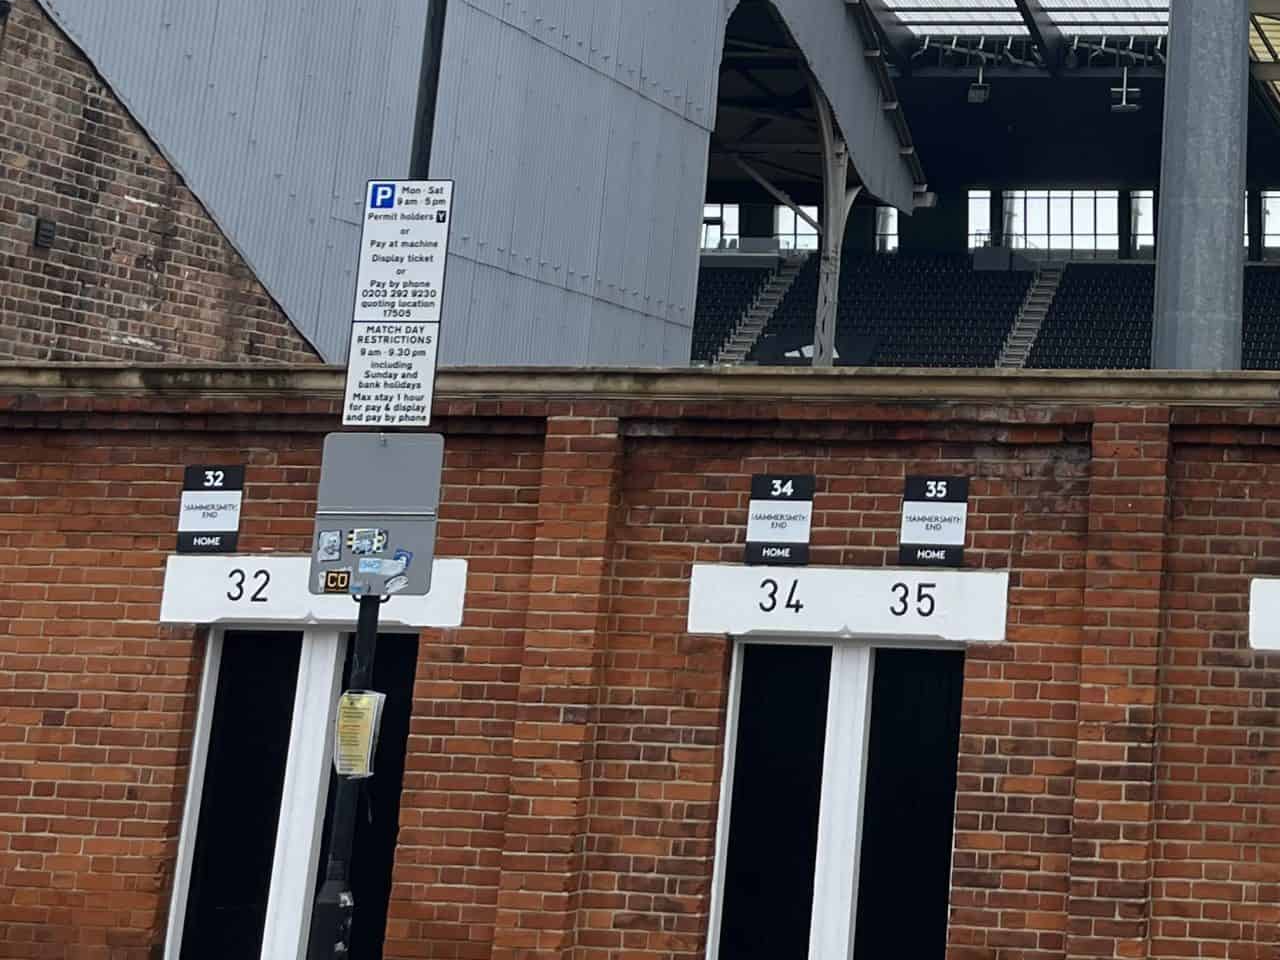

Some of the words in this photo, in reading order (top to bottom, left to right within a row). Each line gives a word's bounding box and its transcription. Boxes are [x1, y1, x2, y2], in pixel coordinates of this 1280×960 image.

[401, 186, 421, 194] Mon
[428, 186, 444, 194] Sat
[375, 186, 393, 207] P
[397, 197, 403, 206] 9
[404, 198, 418, 206] am
[425, 197, 431, 205] 5
[432, 198, 446, 207] pm
[367, 212, 398, 221] Permit
[400, 212, 434, 221] holders
[438, 211, 446, 222] Y
[370, 239, 386, 249] Pay
[388, 239, 398, 248] at
[401, 239, 438, 248] machine
[371, 253, 405, 264] Display
[407, 253, 434, 263] ticket
[396, 268, 406, 276] or
[370, 279, 386, 289] Pay
[388, 279, 400, 289] by
[402, 280, 431, 289] phone
[361, 289, 387, 298] 0203
[361, 300, 396, 309] quoting
[398, 300, 435, 308] location
[383, 309, 411, 318] 17505
[366, 325, 402, 334] MATCH
[405, 325, 425, 334] DAY
[357, 335, 432, 344] RESTRICTIONS
[360, 347, 367, 357] 9
[368, 348, 382, 357] am
[412, 349, 426, 358] pm
[370, 360, 413, 371] including
[364, 370, 399, 380] Sunday
[401, 370, 418, 379] and
[358, 380, 382, 389] bank
[383, 380, 422, 390] holidays
[353, 393, 372, 401] Max
[374, 392, 394, 402] stay
[403, 392, 424, 401] hour
[349, 402, 363, 411] for
[364, 403, 382, 413] pay
[384, 403, 391, 412] &
[393, 403, 426, 413] display
[346, 413, 364, 422] and
[365, 413, 383, 423] pay
[384, 413, 396, 423] by
[398, 413, 427, 423] phone
[203, 470, 224, 487] 32
[771, 480, 794, 496] 34
[925, 481, 947, 498] 35
[184, 503, 238, 512] HAMMERSMITH
[202, 511, 218, 520] END
[751, 512, 808, 522] HAMMERSMITH
[906, 515, 961, 524] HAMMERSMITH
[771, 521, 787, 529] END
[925, 524, 942, 532] END
[193, 536, 221, 546] HOME
[762, 547, 791, 558] HOME
[916, 549, 946, 560] HOME
[226, 569, 271, 602] 32
[759, 579, 803, 613] 34
[890, 582, 937, 617] 35
